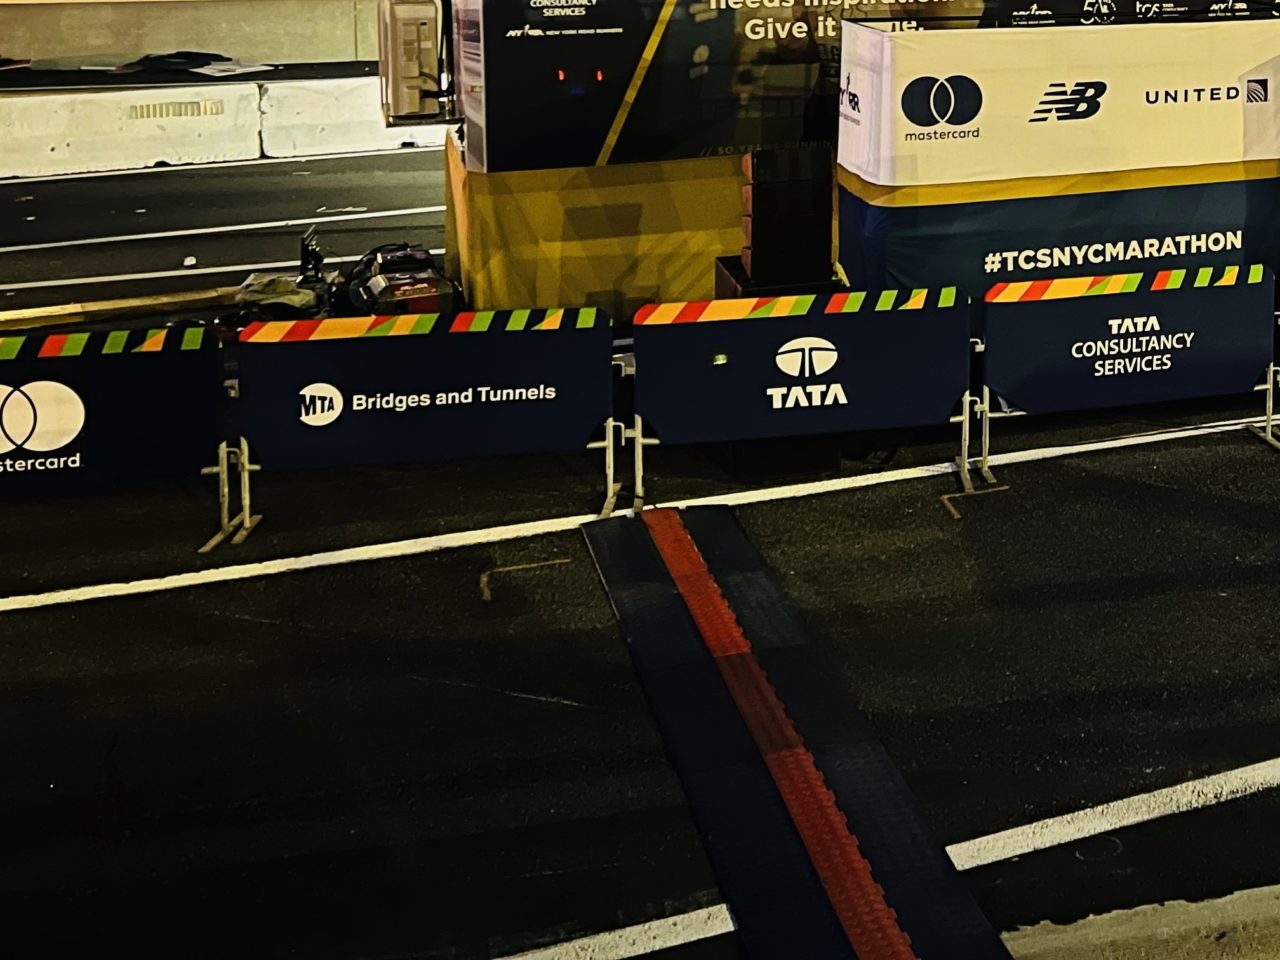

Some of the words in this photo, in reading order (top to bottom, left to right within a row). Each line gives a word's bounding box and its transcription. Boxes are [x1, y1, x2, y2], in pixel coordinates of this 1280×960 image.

[543, 7, 586, 17] SERVICES
[744, 18, 809, 40] Give
[817, 16, 837, 37] it
[1145, 86, 1240, 105] UNITED
[904, 127, 981, 142] mastercard
[984, 230, 1244, 274] #TCSNYCMARATHON
[1108, 315, 1160, 335] TATA
[1071, 332, 1195, 359] CONSULTANCY
[1093, 353, 1172, 378] SERVICES
[300, 393, 335, 418] MTA
[352, 389, 432, 413] Bridges
[435, 386, 473, 406] and
[477, 382, 557, 403] Tunnels
[766, 382, 849, 410] TATA
[0, 452, 81, 473] stercard
